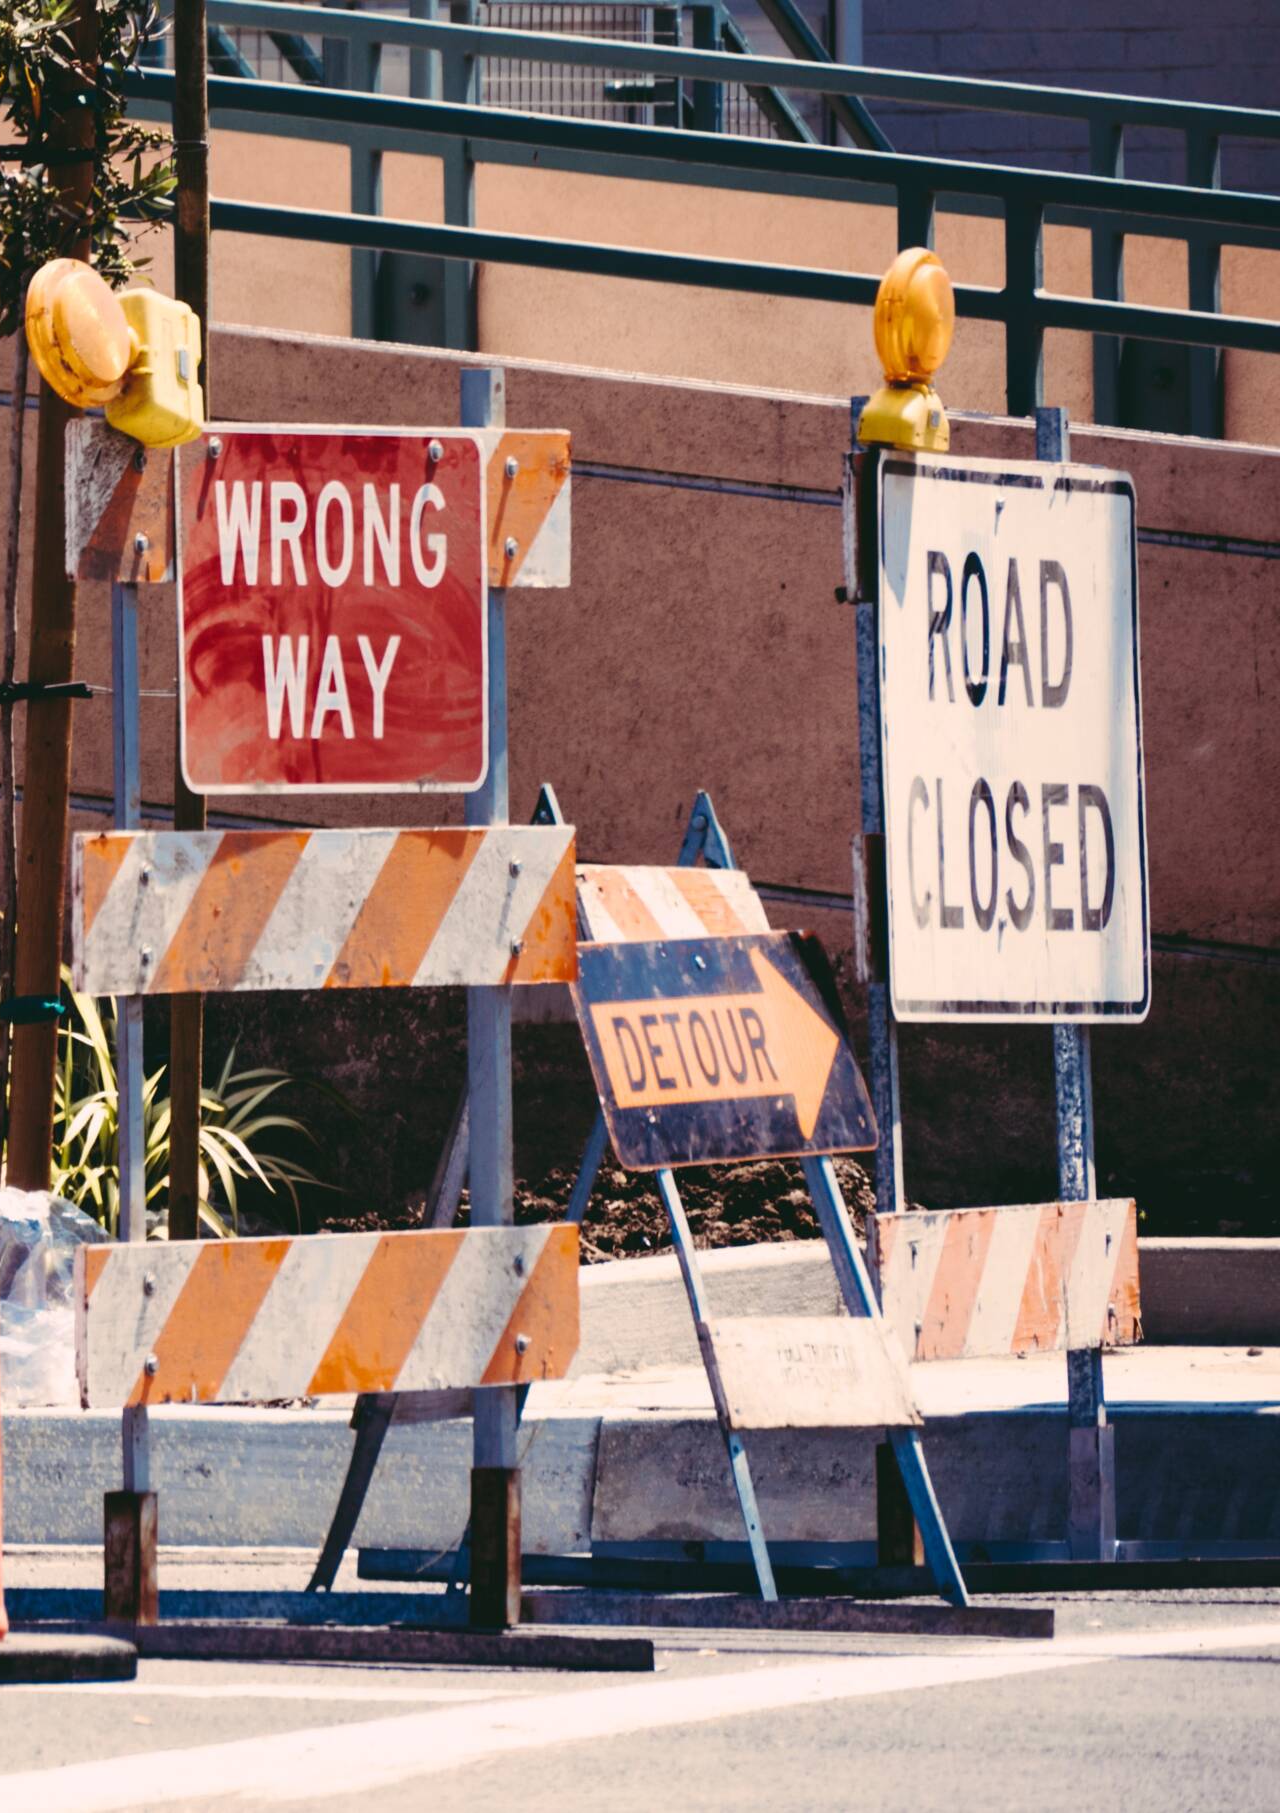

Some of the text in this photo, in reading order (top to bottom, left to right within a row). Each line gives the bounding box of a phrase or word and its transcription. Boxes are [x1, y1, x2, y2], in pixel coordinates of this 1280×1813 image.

[214, 479, 448, 589] WRONG
[926, 550, 1074, 709] ROAD
[262, 634, 402, 740] WAY
[907, 775, 1116, 932] CLOSED
[611, 1007, 779, 1092] DETOUR
